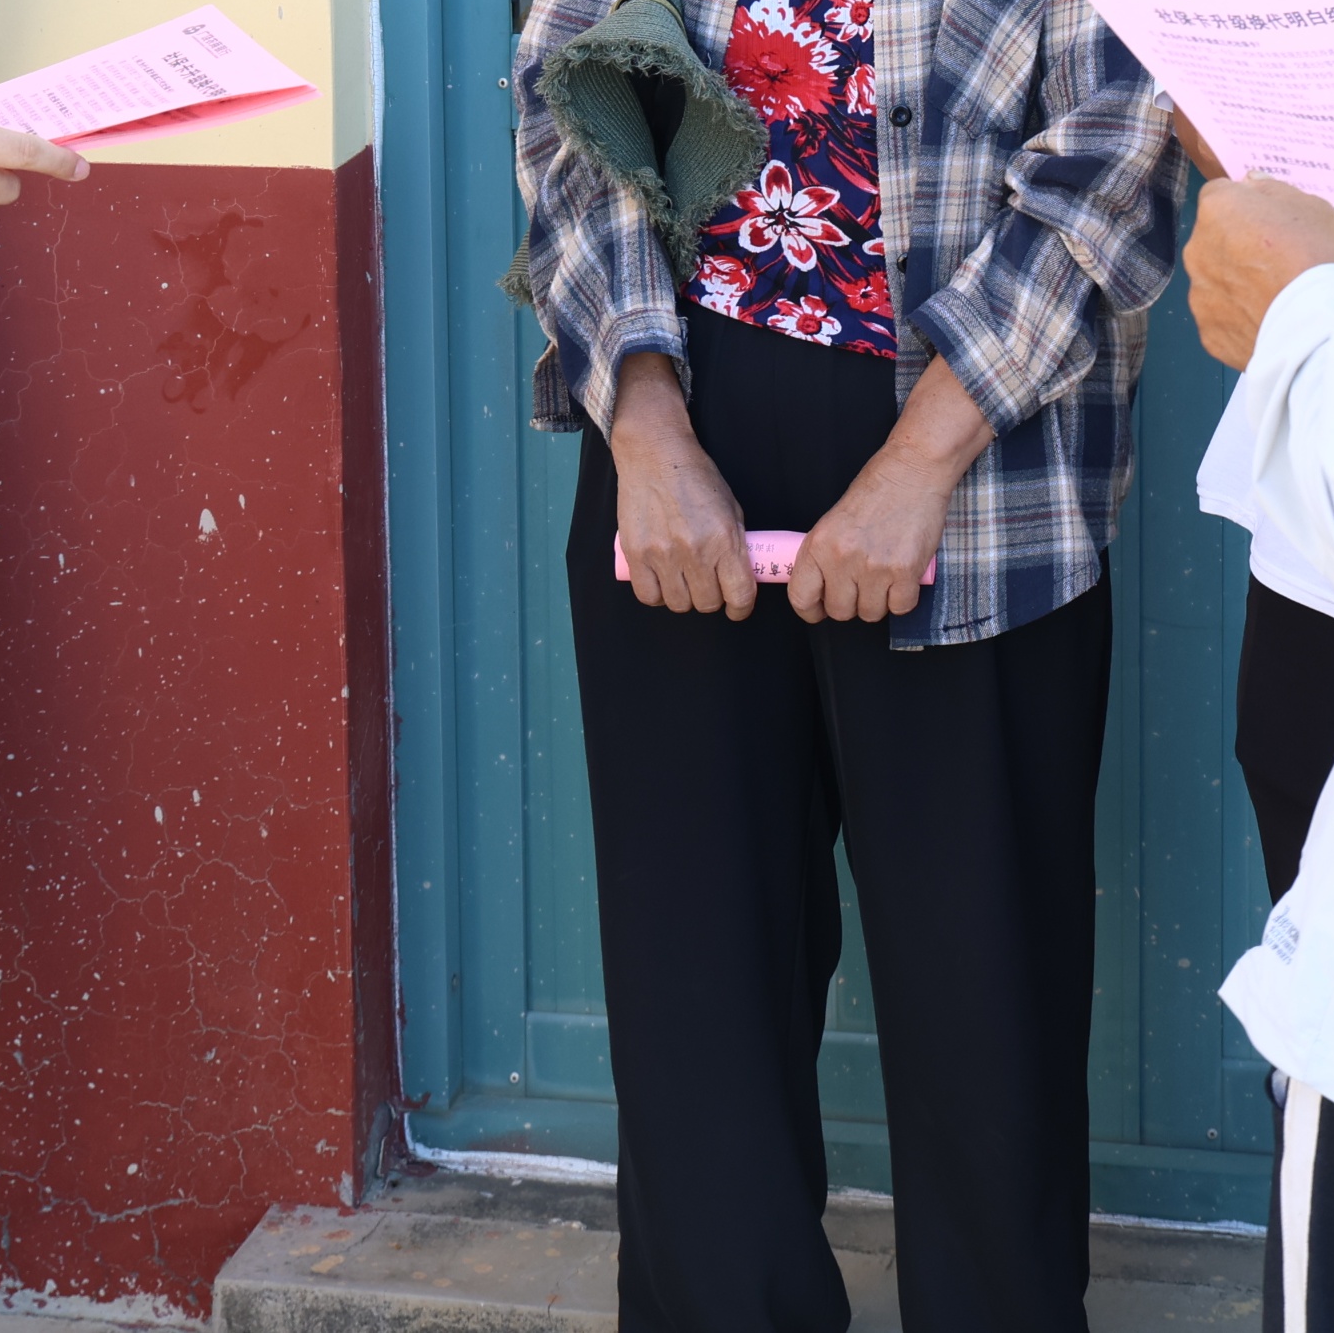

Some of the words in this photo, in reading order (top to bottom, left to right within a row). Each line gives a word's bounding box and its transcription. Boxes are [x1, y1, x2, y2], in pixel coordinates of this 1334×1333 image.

[161, 51, 231, 98] 社保卡升级换代明
